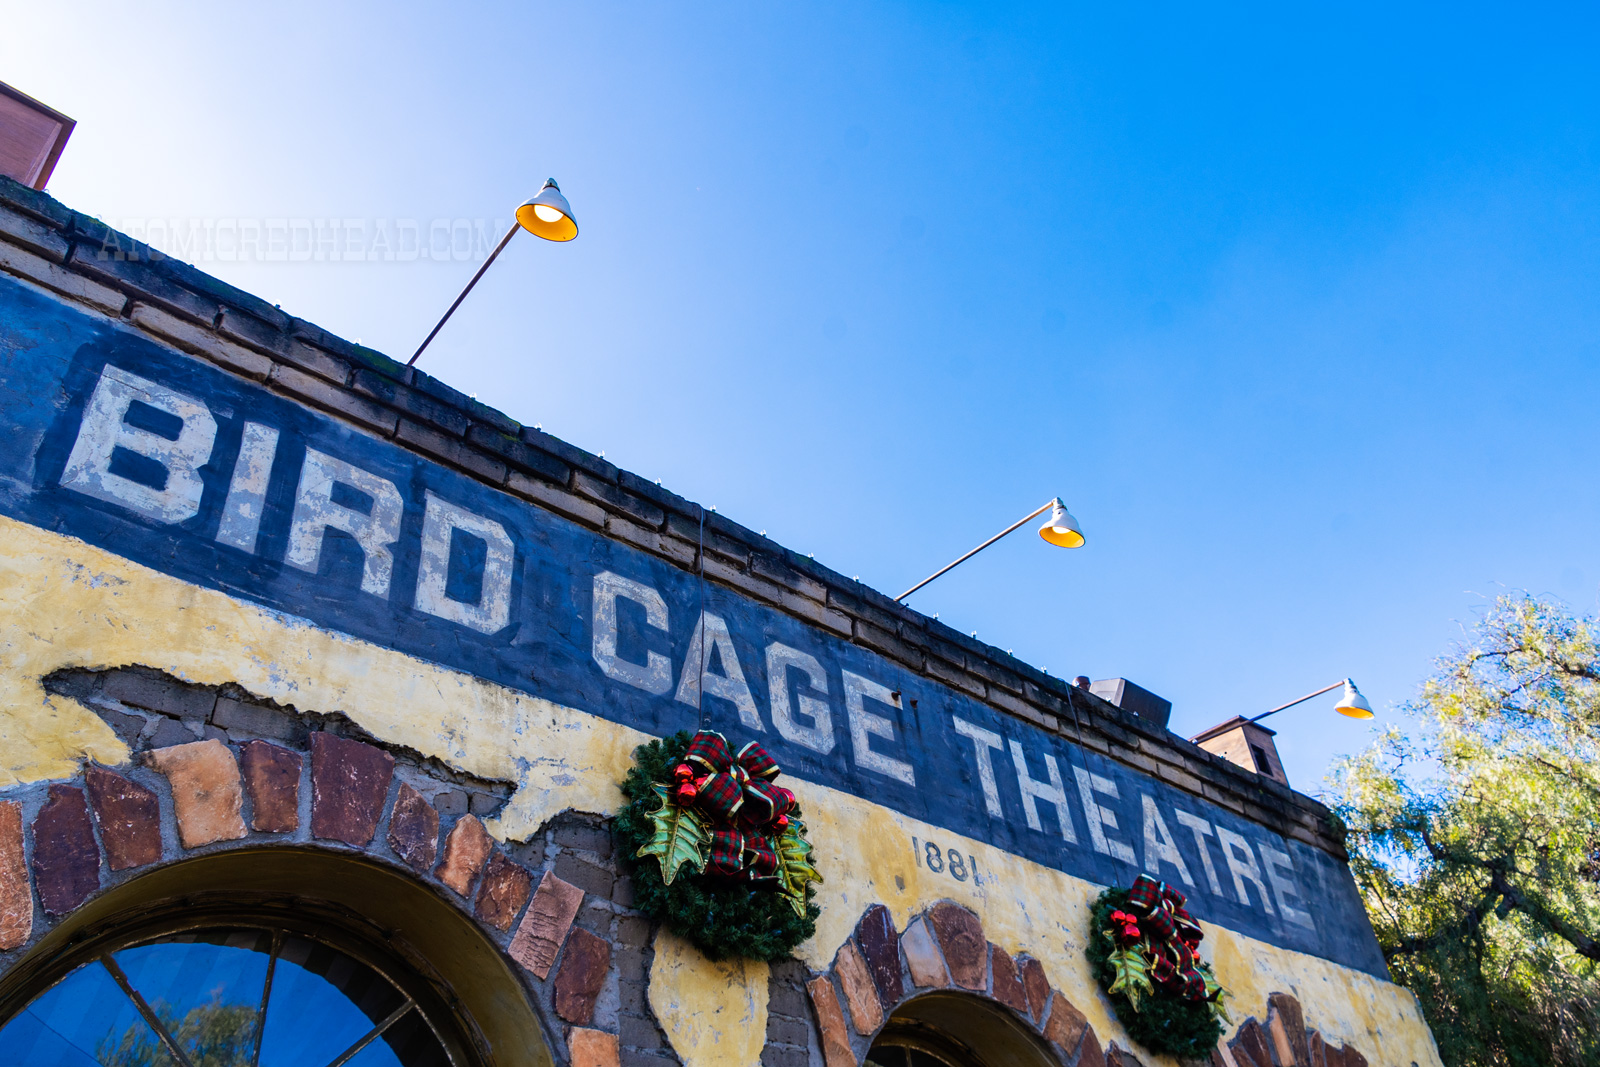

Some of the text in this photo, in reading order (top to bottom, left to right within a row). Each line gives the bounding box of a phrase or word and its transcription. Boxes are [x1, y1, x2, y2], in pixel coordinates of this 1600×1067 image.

[60, 363, 1315, 931] BIRD CAGE THEATRE
[912, 836, 979, 887] 1881
